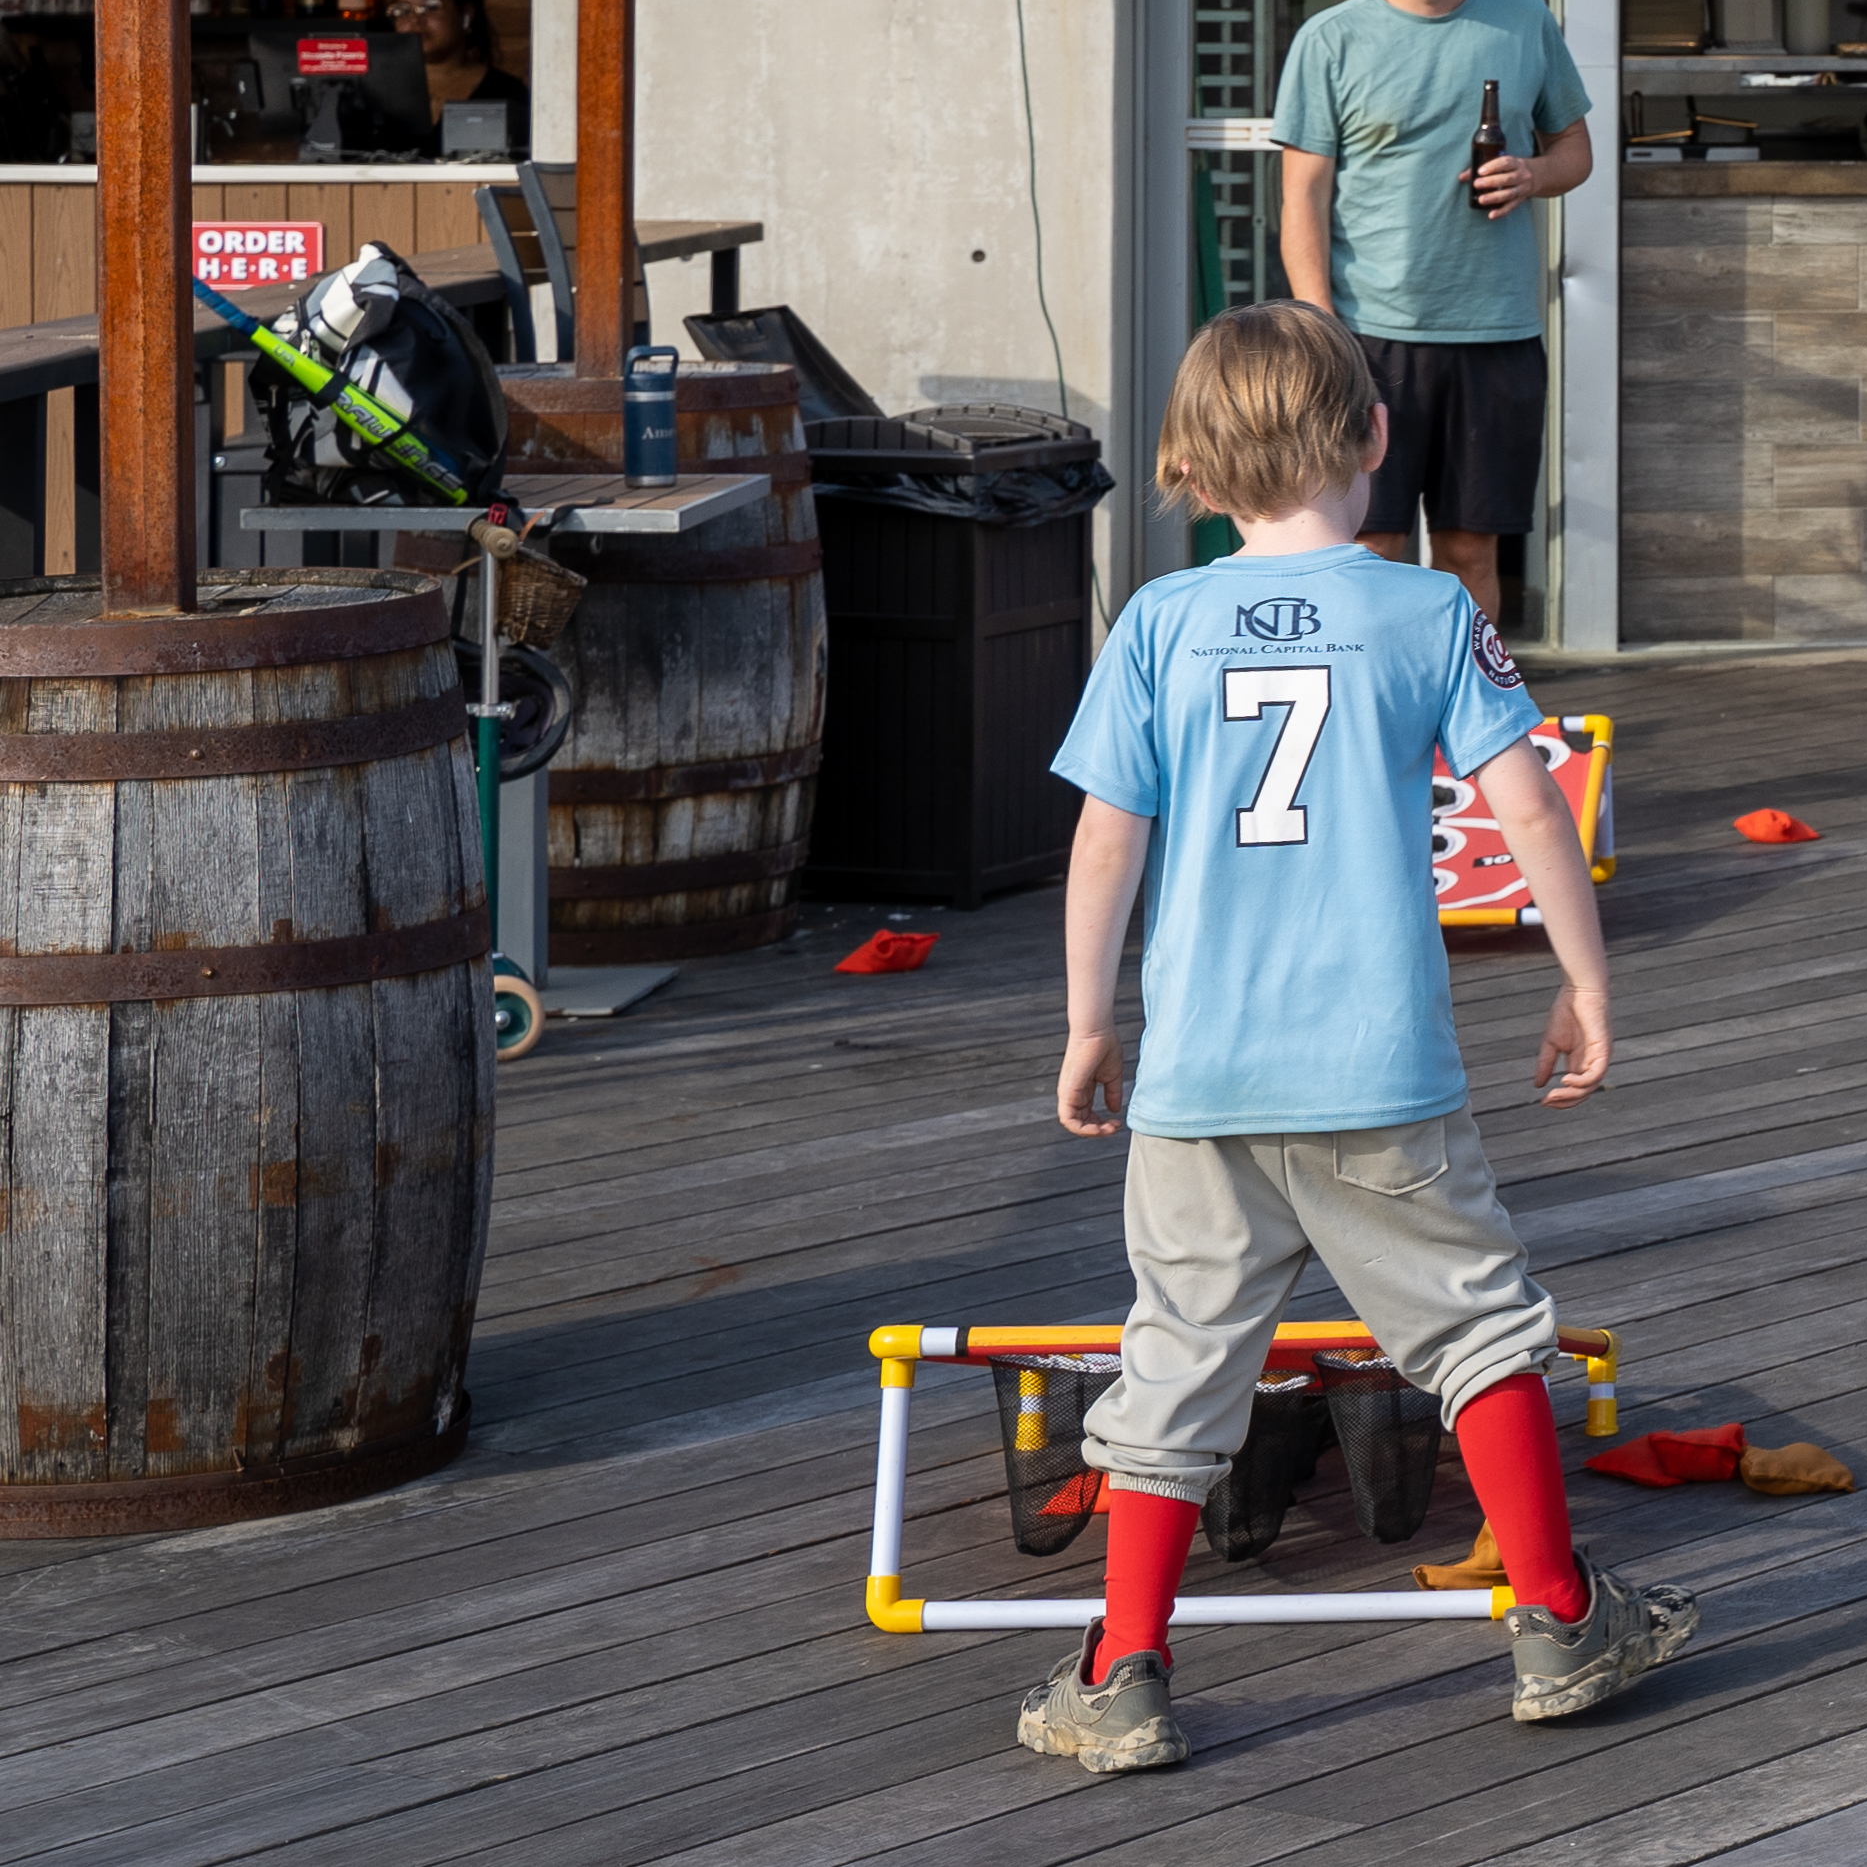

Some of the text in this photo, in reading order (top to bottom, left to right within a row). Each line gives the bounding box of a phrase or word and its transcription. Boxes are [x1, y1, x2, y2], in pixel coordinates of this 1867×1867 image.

[198, 230, 305, 255] ORDER
[1190, 642, 1365, 659] NATIONAL CAPITAL BANK
[1223, 664, 1331, 848] 7
